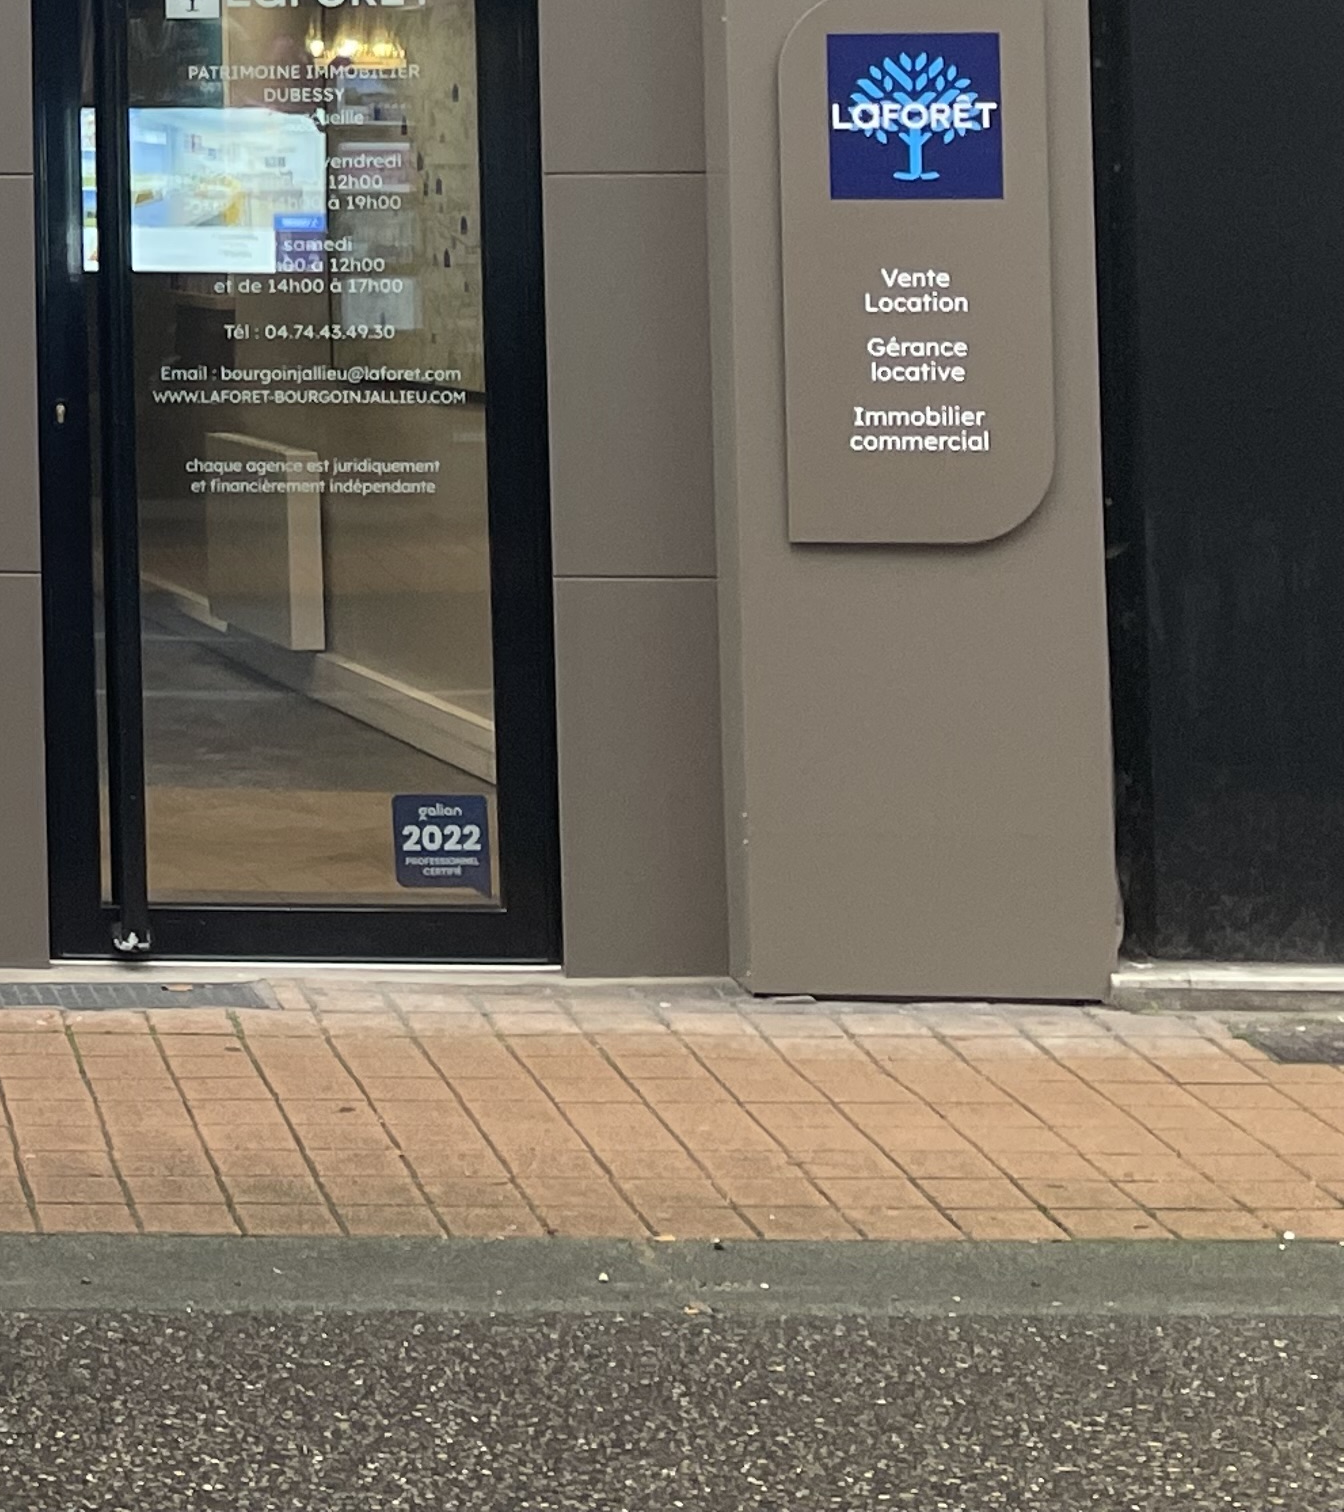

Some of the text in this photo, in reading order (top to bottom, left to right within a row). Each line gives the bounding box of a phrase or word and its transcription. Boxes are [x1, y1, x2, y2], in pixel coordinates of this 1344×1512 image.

[188, 64, 420, 80] PATRIMOINE IMMOBILIER
[263, 88, 345, 102] DUBESSY
[329, 175, 383, 190] 12h00
[328, 193, 340, 210] à
[346, 194, 402, 210] 19h00
[283, 236, 353, 252] samedi
[329, 257, 386, 273] 12h00
[213, 278, 404, 294] et de 14h00 à 17h00
[880, 268, 951, 289] Vente
[864, 292, 969, 313] Location
[223, 324, 250, 339] Tél
[264, 324, 395, 340] 04.74.43.49.30
[866, 336, 969, 358] Gérance
[160, 365, 208, 381] Email
[221, 366, 462, 385] bourgoinjallieu@laforet.com
[870, 361, 966, 382] locative
[152, 390, 466, 405] WWW.LAFORET-BOURGOINJALLIEU.COM
[853, 405, 986, 427] Immobilier
[849, 430, 990, 452] commercial
[185, 457, 440, 475] chaque agence est juridiquement
[190, 477, 436, 496] et financièrement indépendante
[417, 802, 462, 821] galian
[401, 824, 482, 851] 2022
